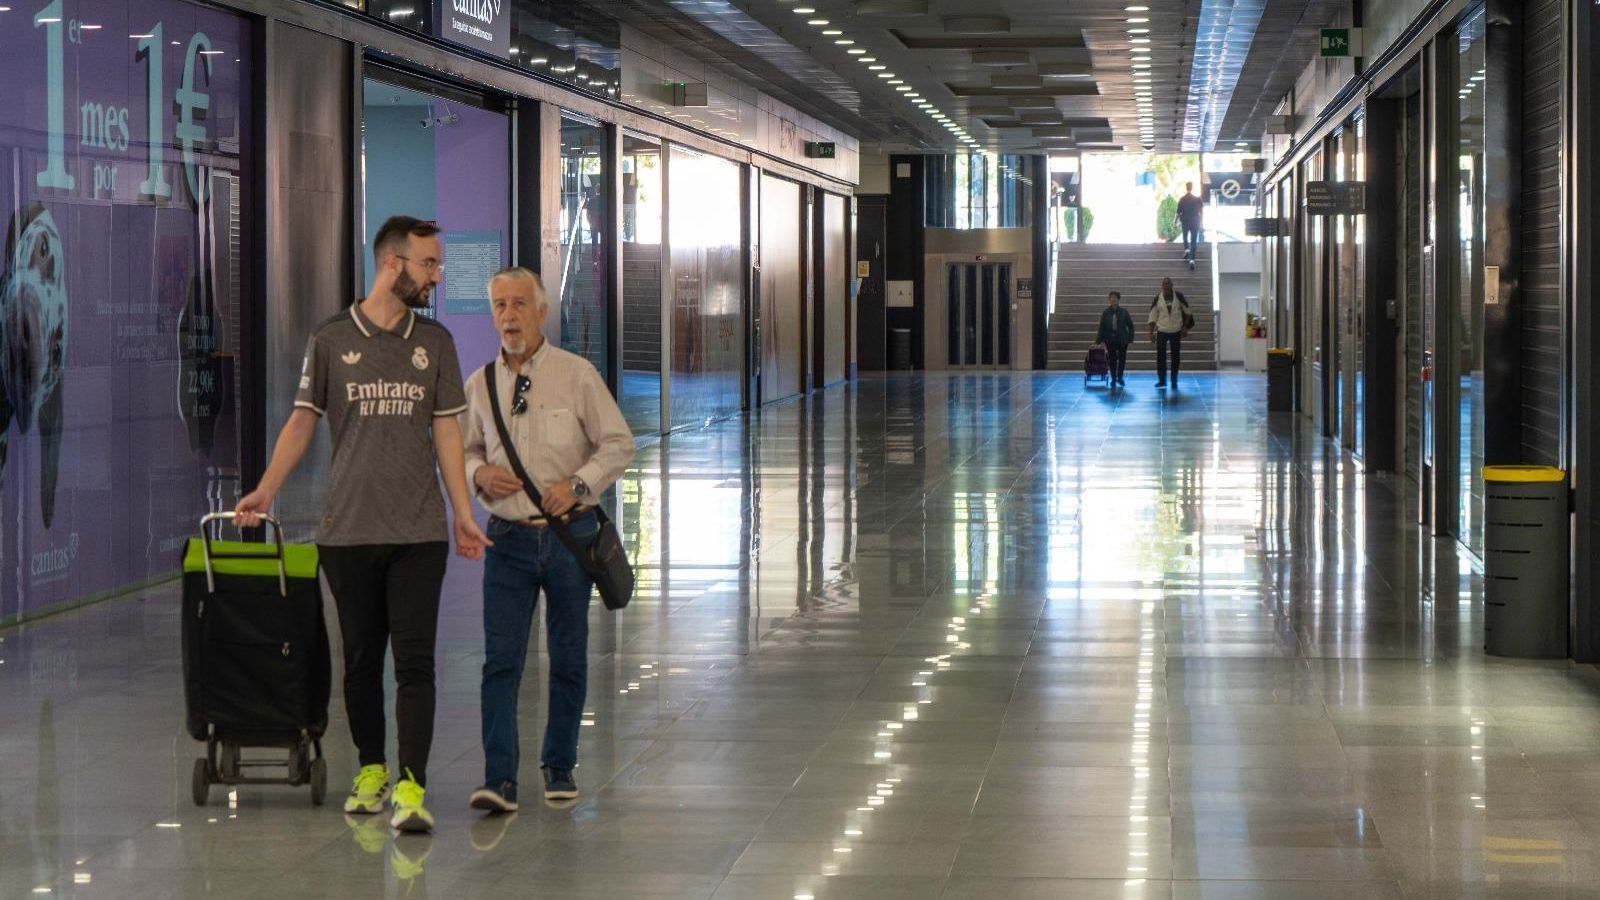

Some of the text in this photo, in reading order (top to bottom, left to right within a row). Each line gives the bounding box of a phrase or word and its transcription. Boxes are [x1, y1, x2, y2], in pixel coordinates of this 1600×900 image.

[81, 101, 129, 151] mes
[94, 164, 118, 200] por
[193, 315, 209, 330] TODO
[187, 370, 215, 395] 22,90€
[346, 378, 426, 401] Emirates
[360, 400, 414, 416] FLY BETTER
